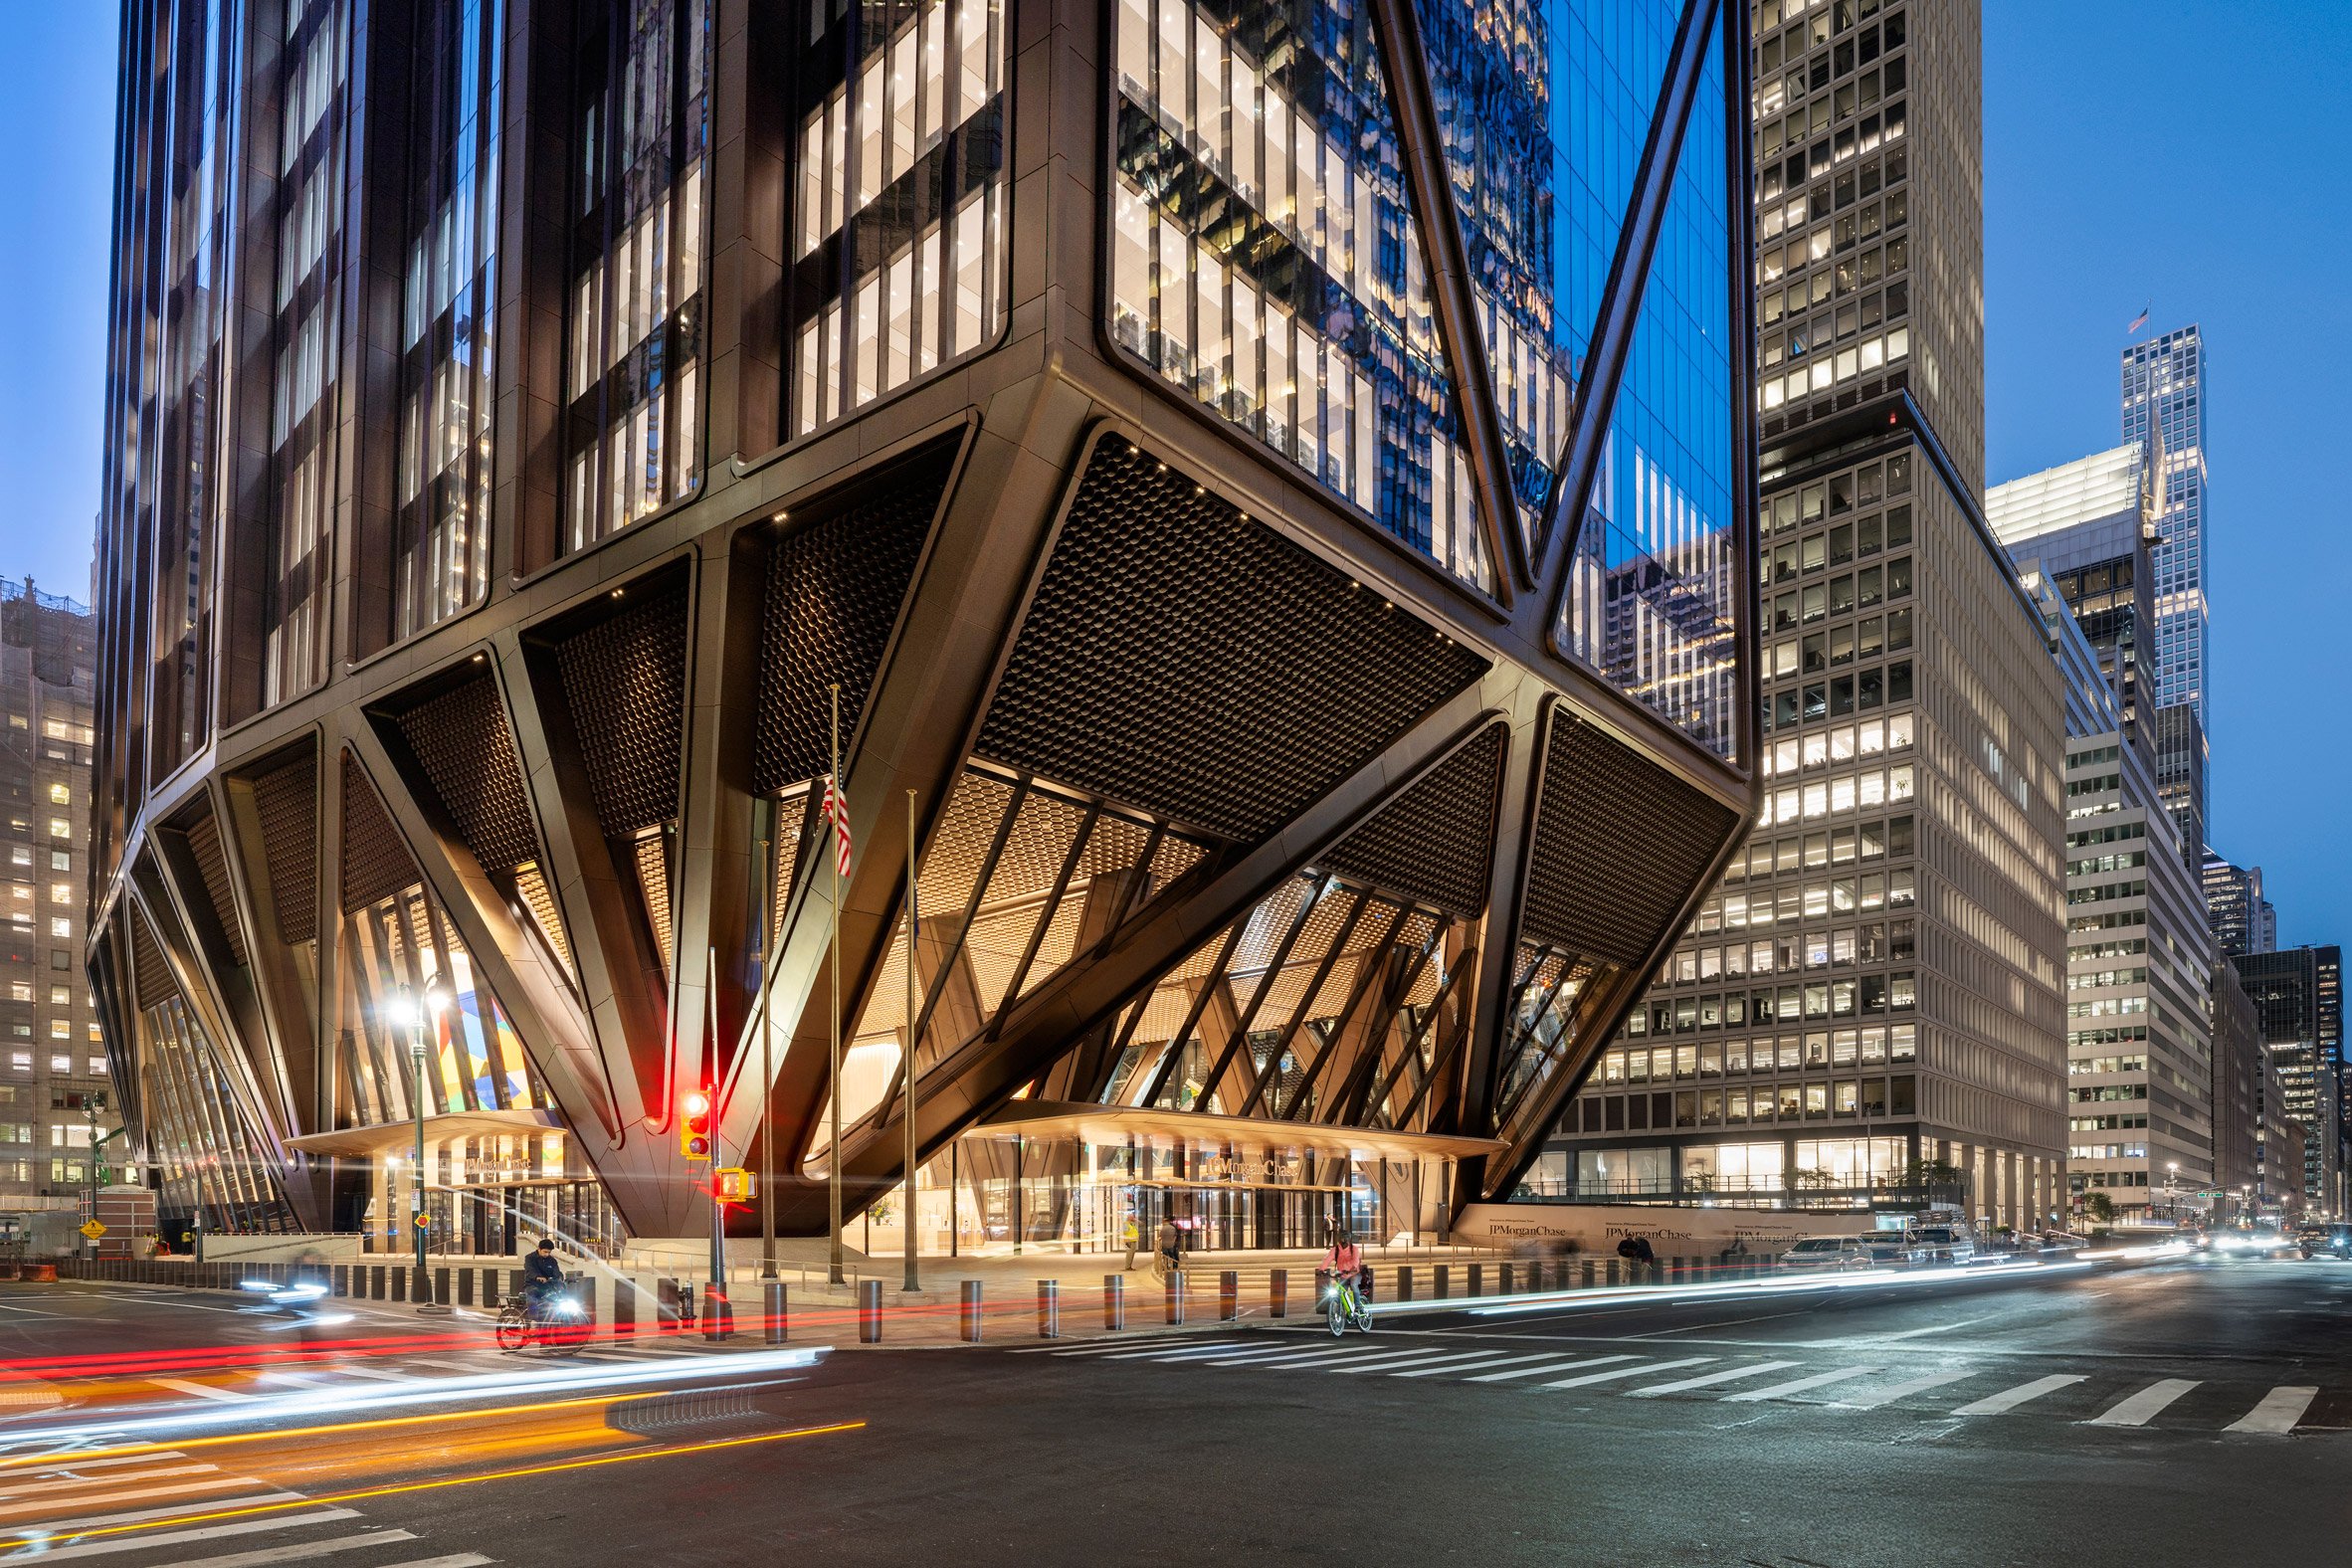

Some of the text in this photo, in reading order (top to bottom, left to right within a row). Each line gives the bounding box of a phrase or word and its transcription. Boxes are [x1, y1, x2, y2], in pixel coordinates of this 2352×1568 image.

[1206, 1157, 1298, 1181] JPMorganChase
[1489, 1225, 1566, 1238] JPMorganChase
[1605, 1228, 1691, 1241] JPMorganChase
